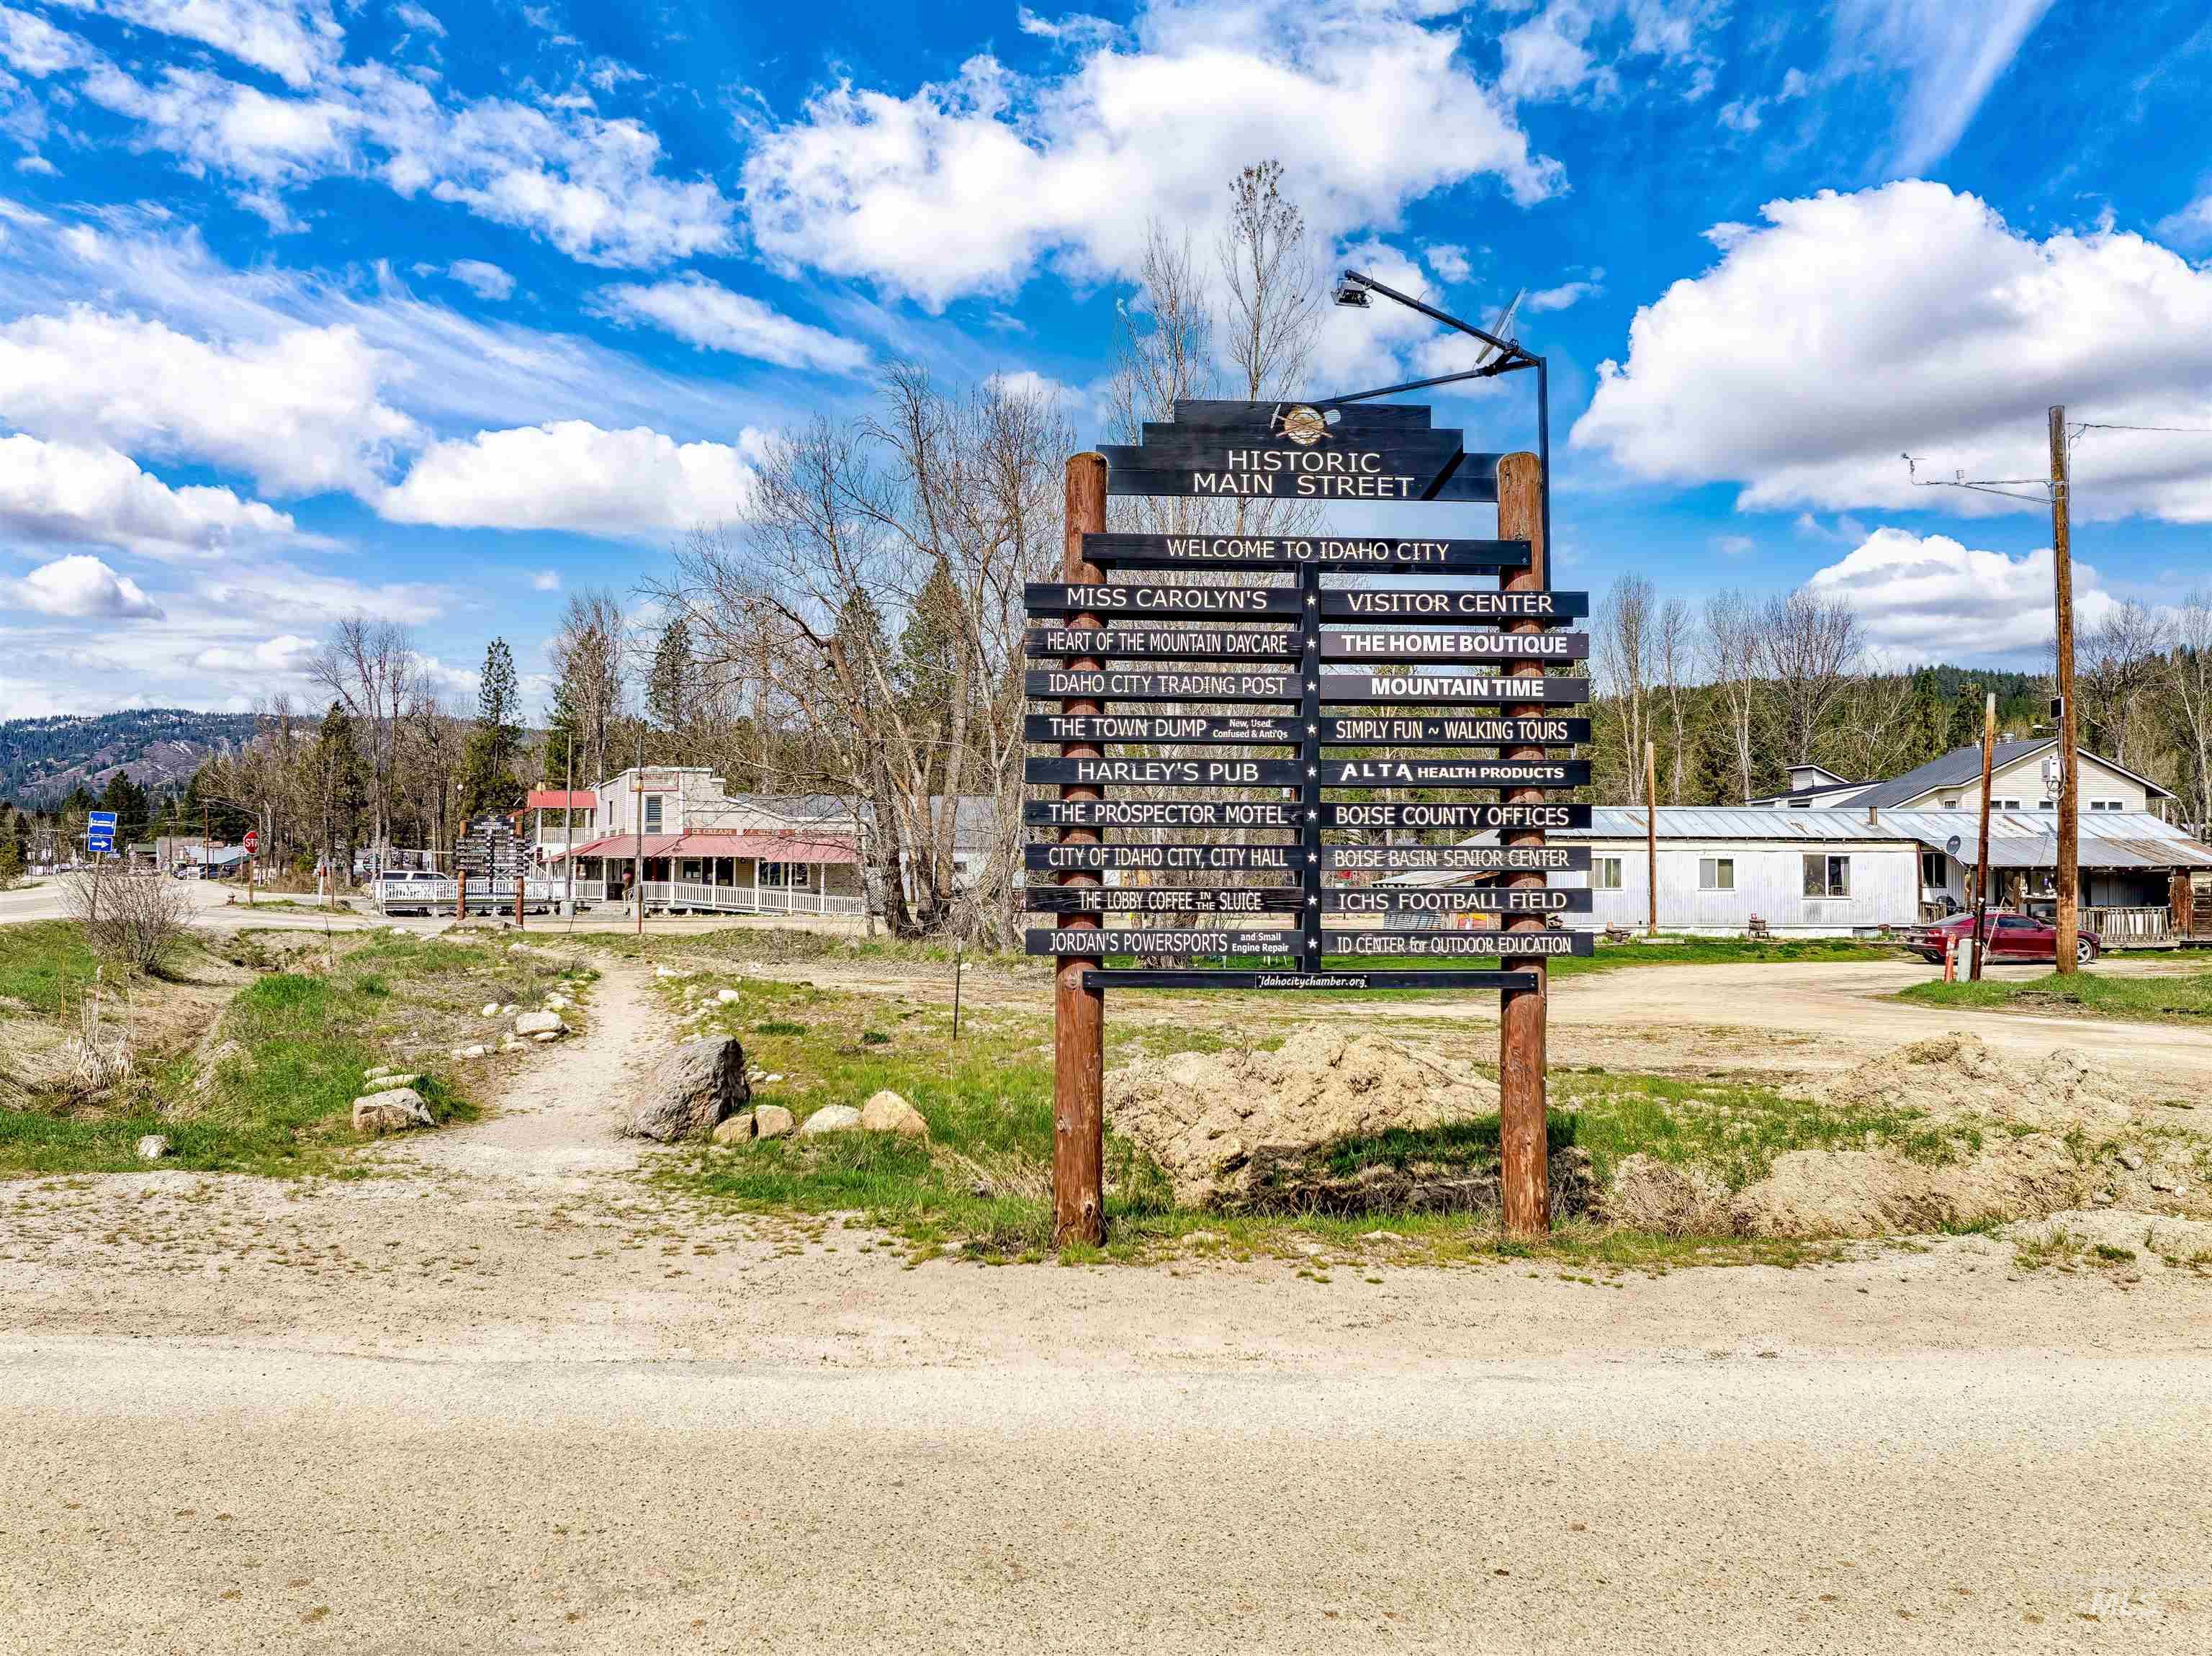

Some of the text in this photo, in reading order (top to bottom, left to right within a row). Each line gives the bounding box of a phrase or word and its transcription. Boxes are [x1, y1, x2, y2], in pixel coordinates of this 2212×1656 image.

[1228, 451, 1380, 474] HISTORIC
[1194, 472, 1414, 496] MAIN STREET
[1167, 539, 1449, 561] WELCOME TO IDAHO CITY
[1068, 588, 1267, 609] MISS CAROLYN'S
[1348, 593, 1553, 613] VISITOR CENTER
[1048, 631, 1287, 652] HEART OF THE MOUNTAIN DAYCARE
[1341, 634, 1568, 655] THE HOME BOUTIQUE
[1049, 673, 1287, 695] IDAHO CITY TRADING POST
[1371, 677, 1545, 696] MOUNTAIN TIME
[1049, 718, 1207, 737] THE TOWN DUMP
[1213, 729, 1249, 737] Confused
[1229, 719, 1249, 729] New,
[1335, 721, 1388, 740] SIMPLY
[1394, 721, 1422, 738] FUN
[1444, 721, 1513, 741] WALKING
[1518, 721, 1567, 741] TOURS
[1079, 762, 1258, 783] HARLEY'S PUB
[1341, 763, 1564, 783] ALTA HEALTH PRODUCTS
[1048, 804, 1288, 824] THE PROSPECTOR MOTEL
[1336, 806, 1568, 827] BOISE COUNTY OFFICES
[1049, 847, 1288, 870] CITY OF IDAHO CITY, CITY HALL
[1334, 848, 1569, 868] BOISE BASIN SENIOR CENTER
[1078, 891, 1104, 910] THE
[1107, 891, 1143, 909] LOBBY
[1147, 892, 1193, 909] COFFEE
[1218, 891, 1262, 910] SLUICE
[1338, 891, 1567, 911] ICHS FOOTBALL FIELD
[1049, 932, 1227, 952] JORDAN'S POWERSPORTS
[1239, 931, 1282, 941] and Small
[1336, 935, 1572, 955] ID CENTER for OUTDOOR EDUCATION
[1232, 942, 1289, 953] Engine Repair
